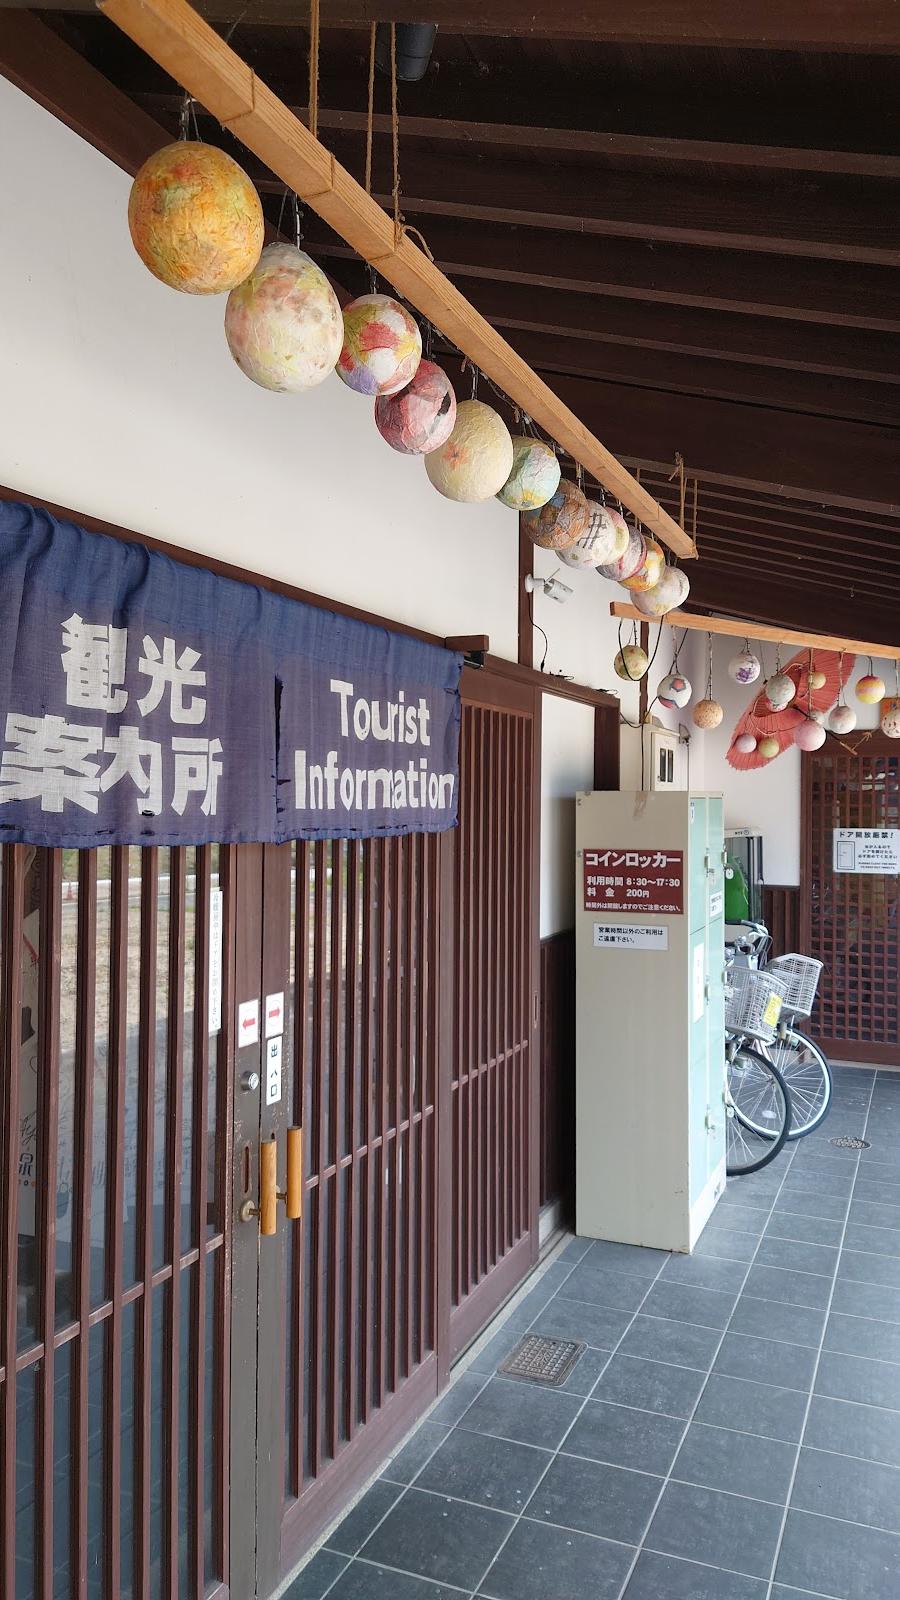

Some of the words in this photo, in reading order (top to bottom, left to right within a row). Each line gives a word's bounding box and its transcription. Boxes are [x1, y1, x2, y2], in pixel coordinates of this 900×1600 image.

[60, 612, 207, 725] 観光
[330, 679, 431, 746] Tourist
[0, 713, 223, 816] 案内所
[294, 749, 455, 810] Information
[585, 850, 681, 868] コインロッカー
[586, 876, 624, 887] 利用時間
[626, 888, 650, 898] 200円
[598, 926, 663, 936] 営業時間以外のご利用は
